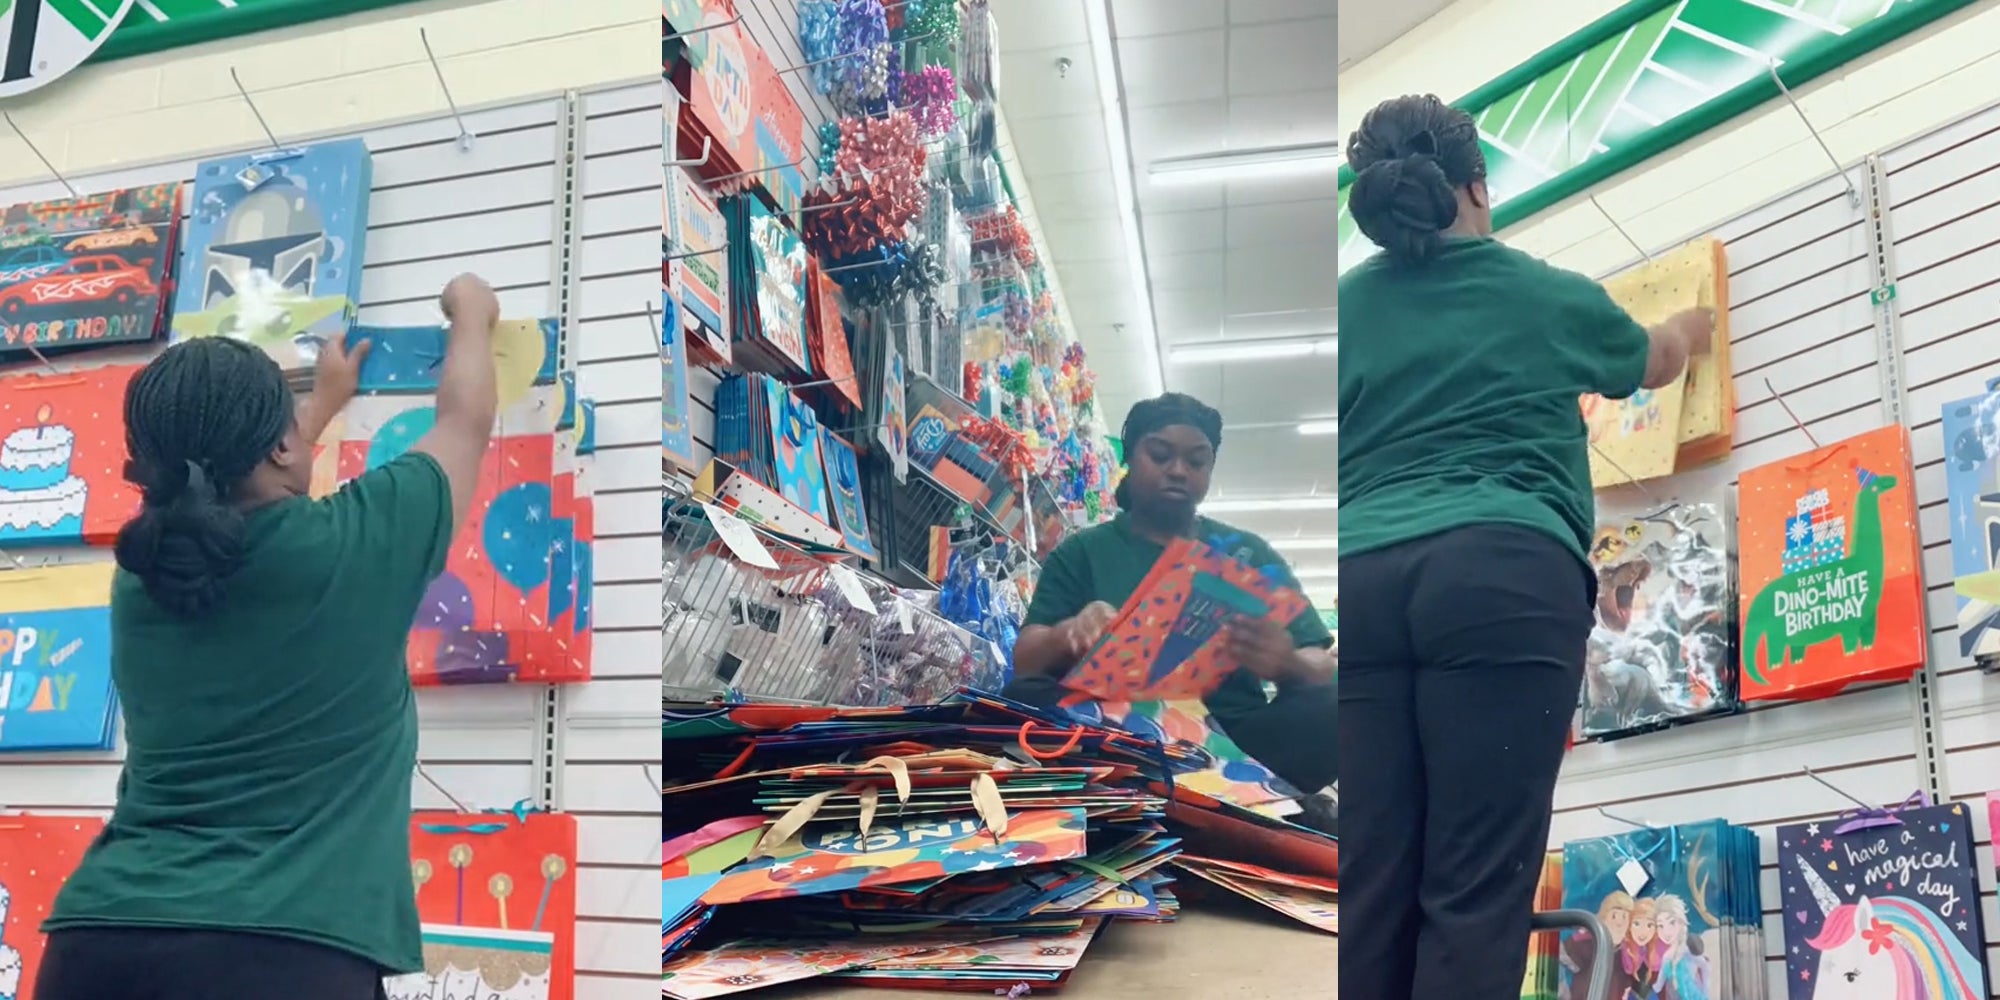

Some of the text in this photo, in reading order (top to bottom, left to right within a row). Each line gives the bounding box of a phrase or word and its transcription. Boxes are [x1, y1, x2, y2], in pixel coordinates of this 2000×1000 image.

[22, 313, 145, 344] BIRTHDAY!
[1774, 570, 1869, 617] DINO-MITE
[1797, 566, 1845, 587] HAVE A
[1785, 593, 1867, 637] BIRTHDAY
[1844, 830, 1916, 867] have a
[1864, 840, 1960, 887] magical
[1917, 872, 1961, 917] day
